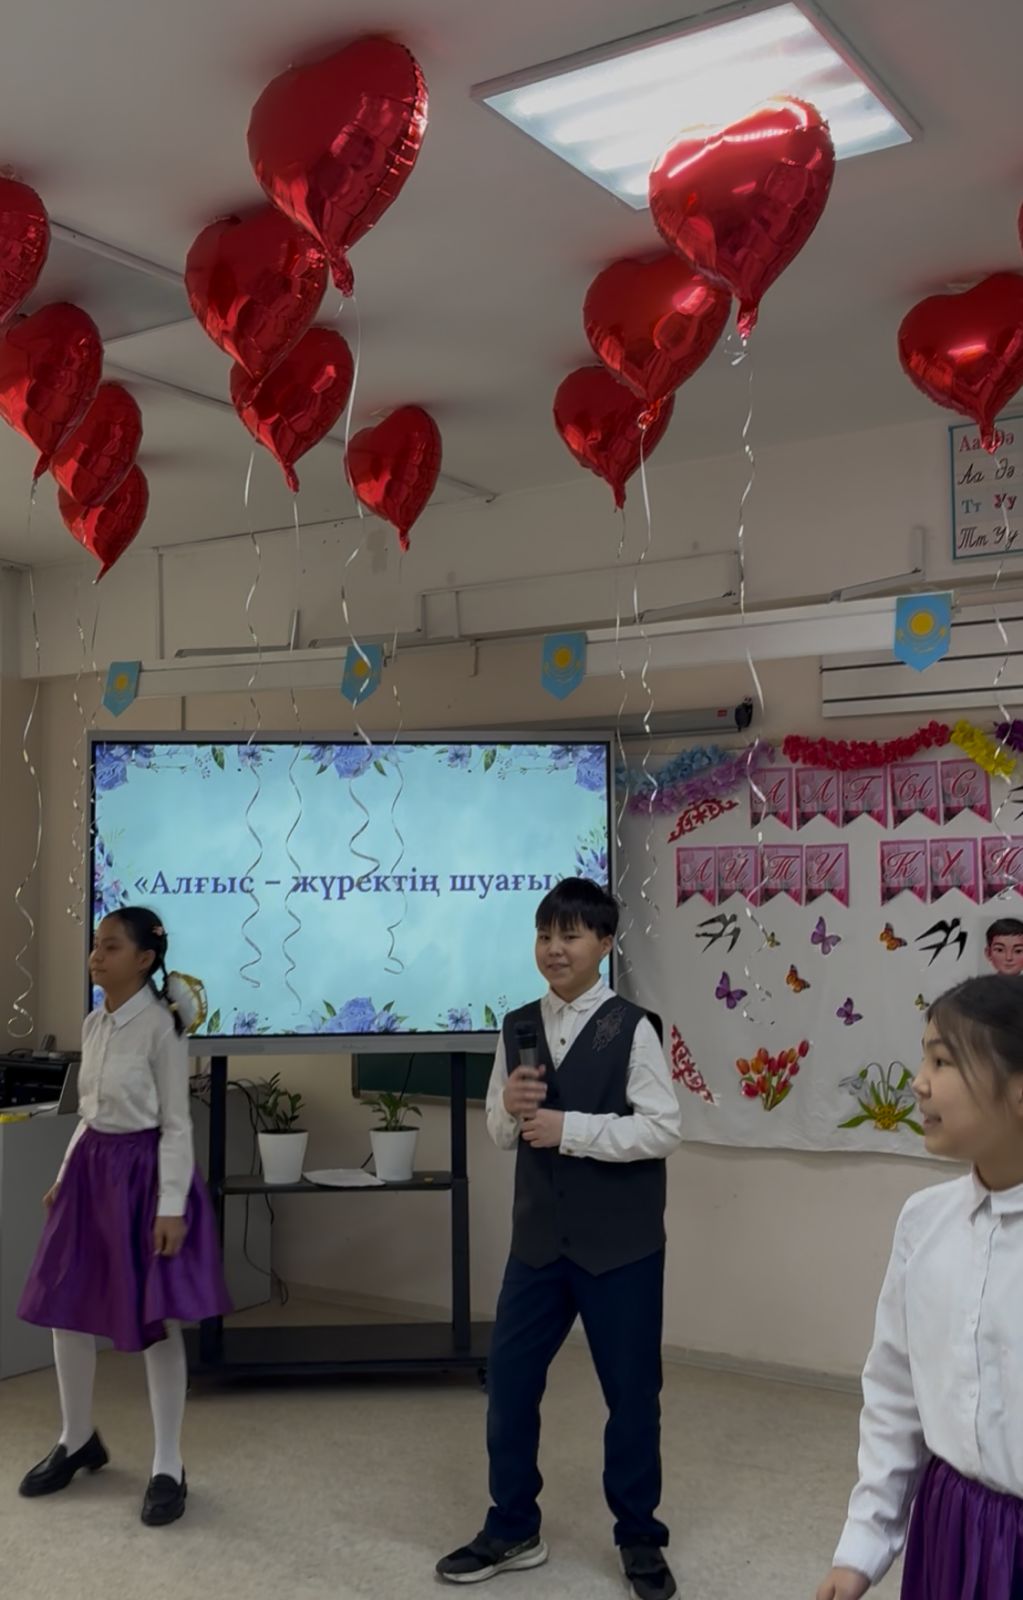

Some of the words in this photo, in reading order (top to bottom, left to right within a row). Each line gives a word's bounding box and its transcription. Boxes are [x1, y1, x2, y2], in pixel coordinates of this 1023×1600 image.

[134, 870, 255, 895] «Алғыс
[291, 866, 440, 901] жүректің
[682, 852, 843, 884] АЙТУ
